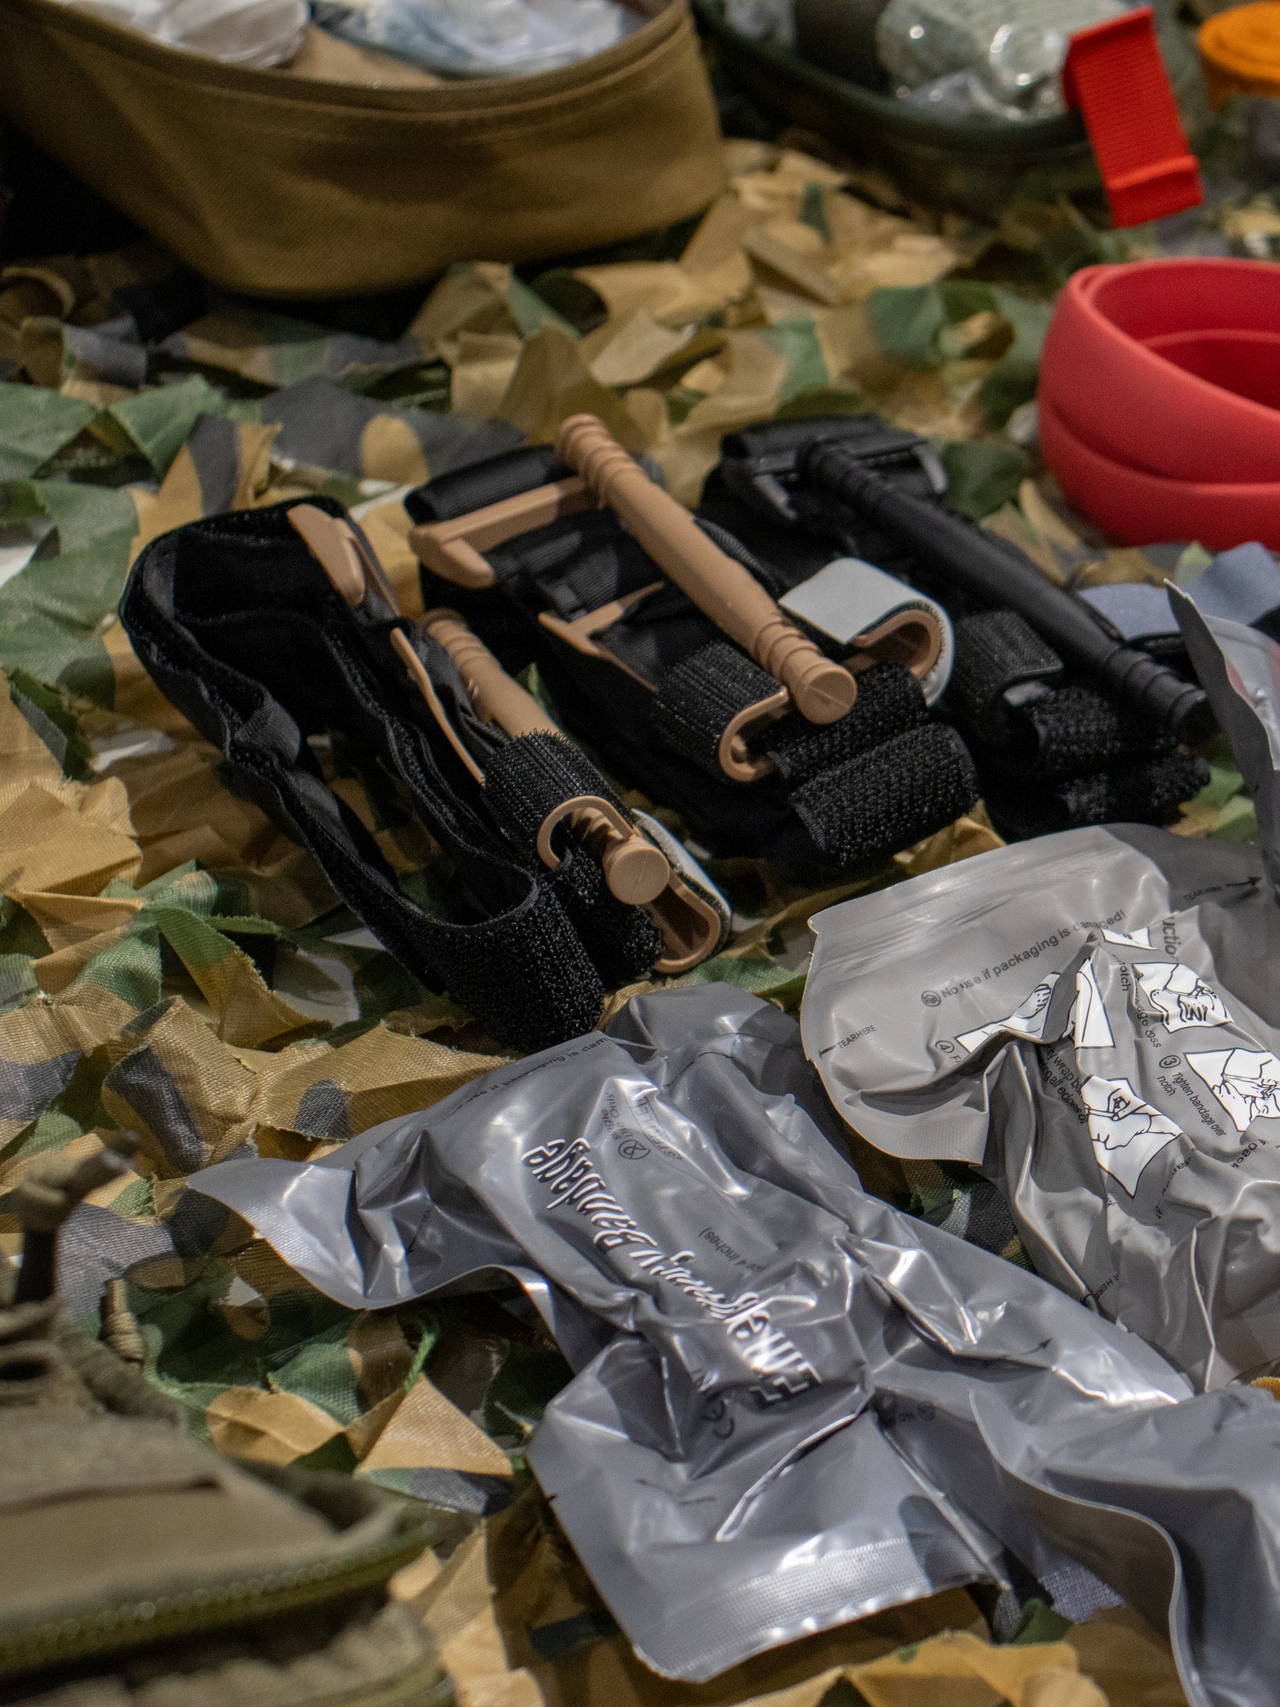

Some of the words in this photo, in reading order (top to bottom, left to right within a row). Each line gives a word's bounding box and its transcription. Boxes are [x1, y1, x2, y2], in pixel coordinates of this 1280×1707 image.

[940, 986, 959, 999] No
[959, 976, 982, 990] use
[981, 968, 992, 981] if
[992, 934, 1059, 977] packaging
[1057, 928, 1071, 941] is
[1072, 910, 1127, 933] damaged!
[1049, 1076, 1063, 1089] all
[1053, 1056, 1075, 1082] wrap
[1157, 1075, 1177, 1098] notch
[1172, 1072, 1194, 1099] Tighten
[1189, 1095, 1215, 1127] bandage
[1209, 1122, 1228, 1138] over
[521, 1137, 658, 1248] Bandage
